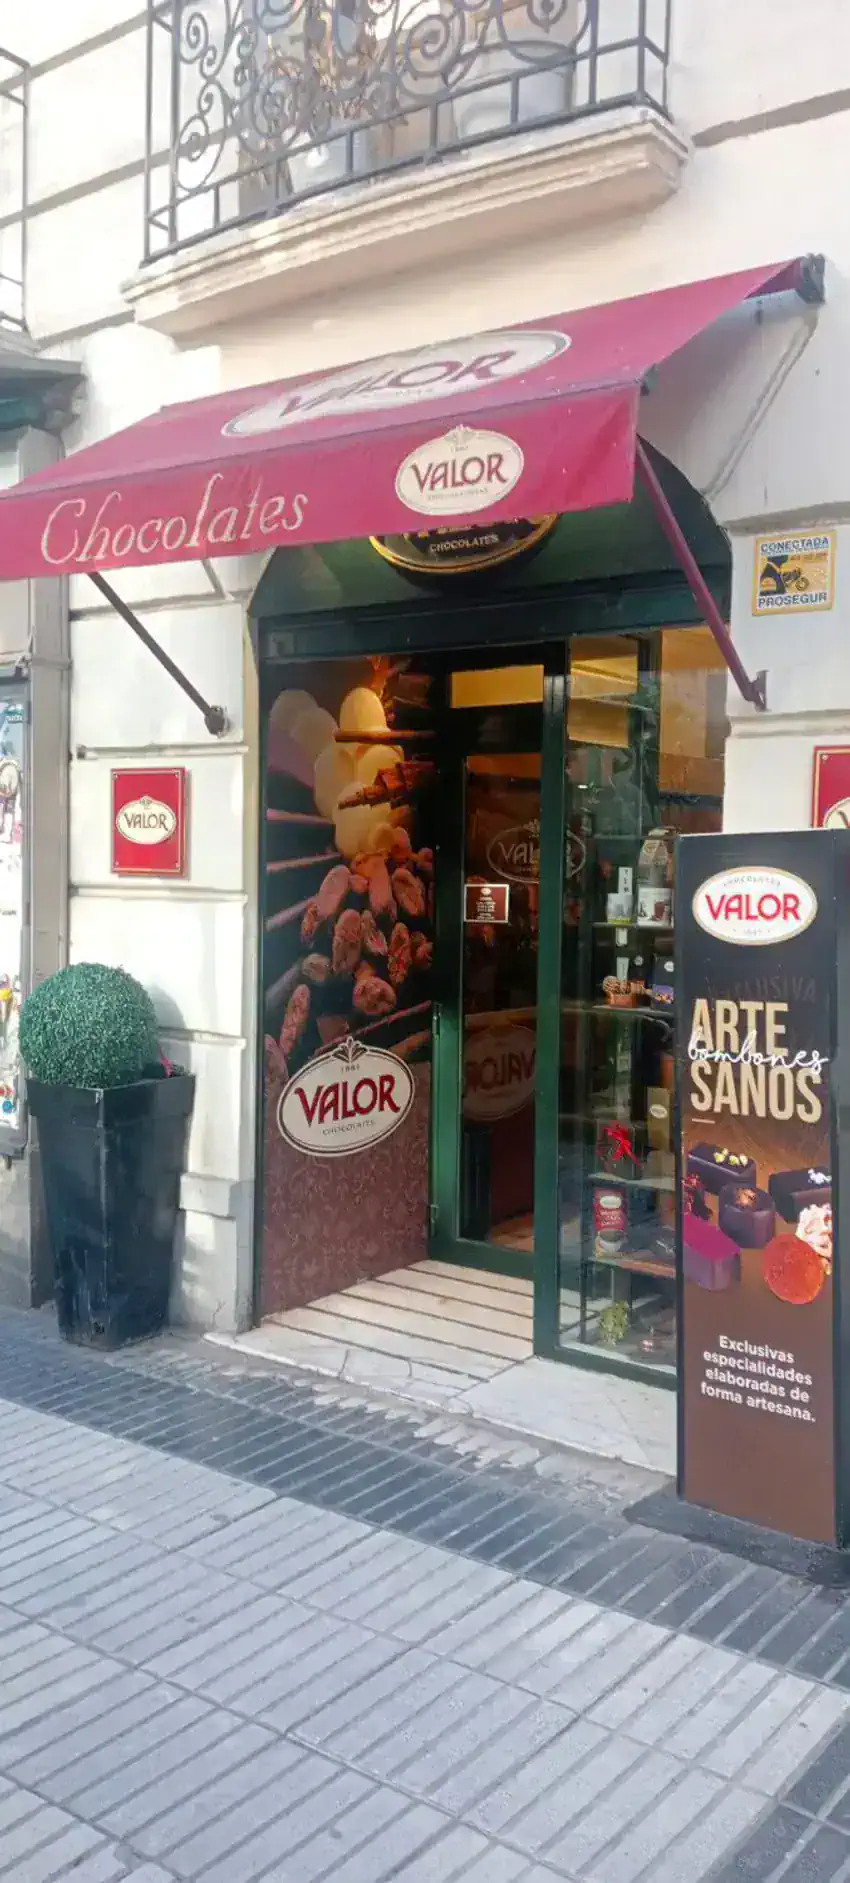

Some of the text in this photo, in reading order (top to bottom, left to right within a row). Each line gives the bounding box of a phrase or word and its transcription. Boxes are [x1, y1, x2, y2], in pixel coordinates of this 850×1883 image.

[279, 350, 516, 417] VALOR
[411, 453, 508, 493] VALOR
[41, 473, 308, 564] Chocolates
[429, 534, 499, 553] CHOCOLATES
[761, 537, 829, 553] CONECTADA
[759, 592, 827, 608] PROSEGUR
[124, 812, 168, 831] VALOR
[705, 893, 801, 921] VALOR
[690, 998, 788, 1056] ARTE
[687, 1027, 829, 1076] bombones
[294, 1073, 401, 1128] VALOR
[690, 1060, 823, 1123] SANOS
[703, 1350, 812, 1386] especialidades
[719, 1335, 795, 1364] Exclusivas
[701, 1381, 816, 1423] forma artesana.
[705, 1367, 810, 1403] elaboradas de
